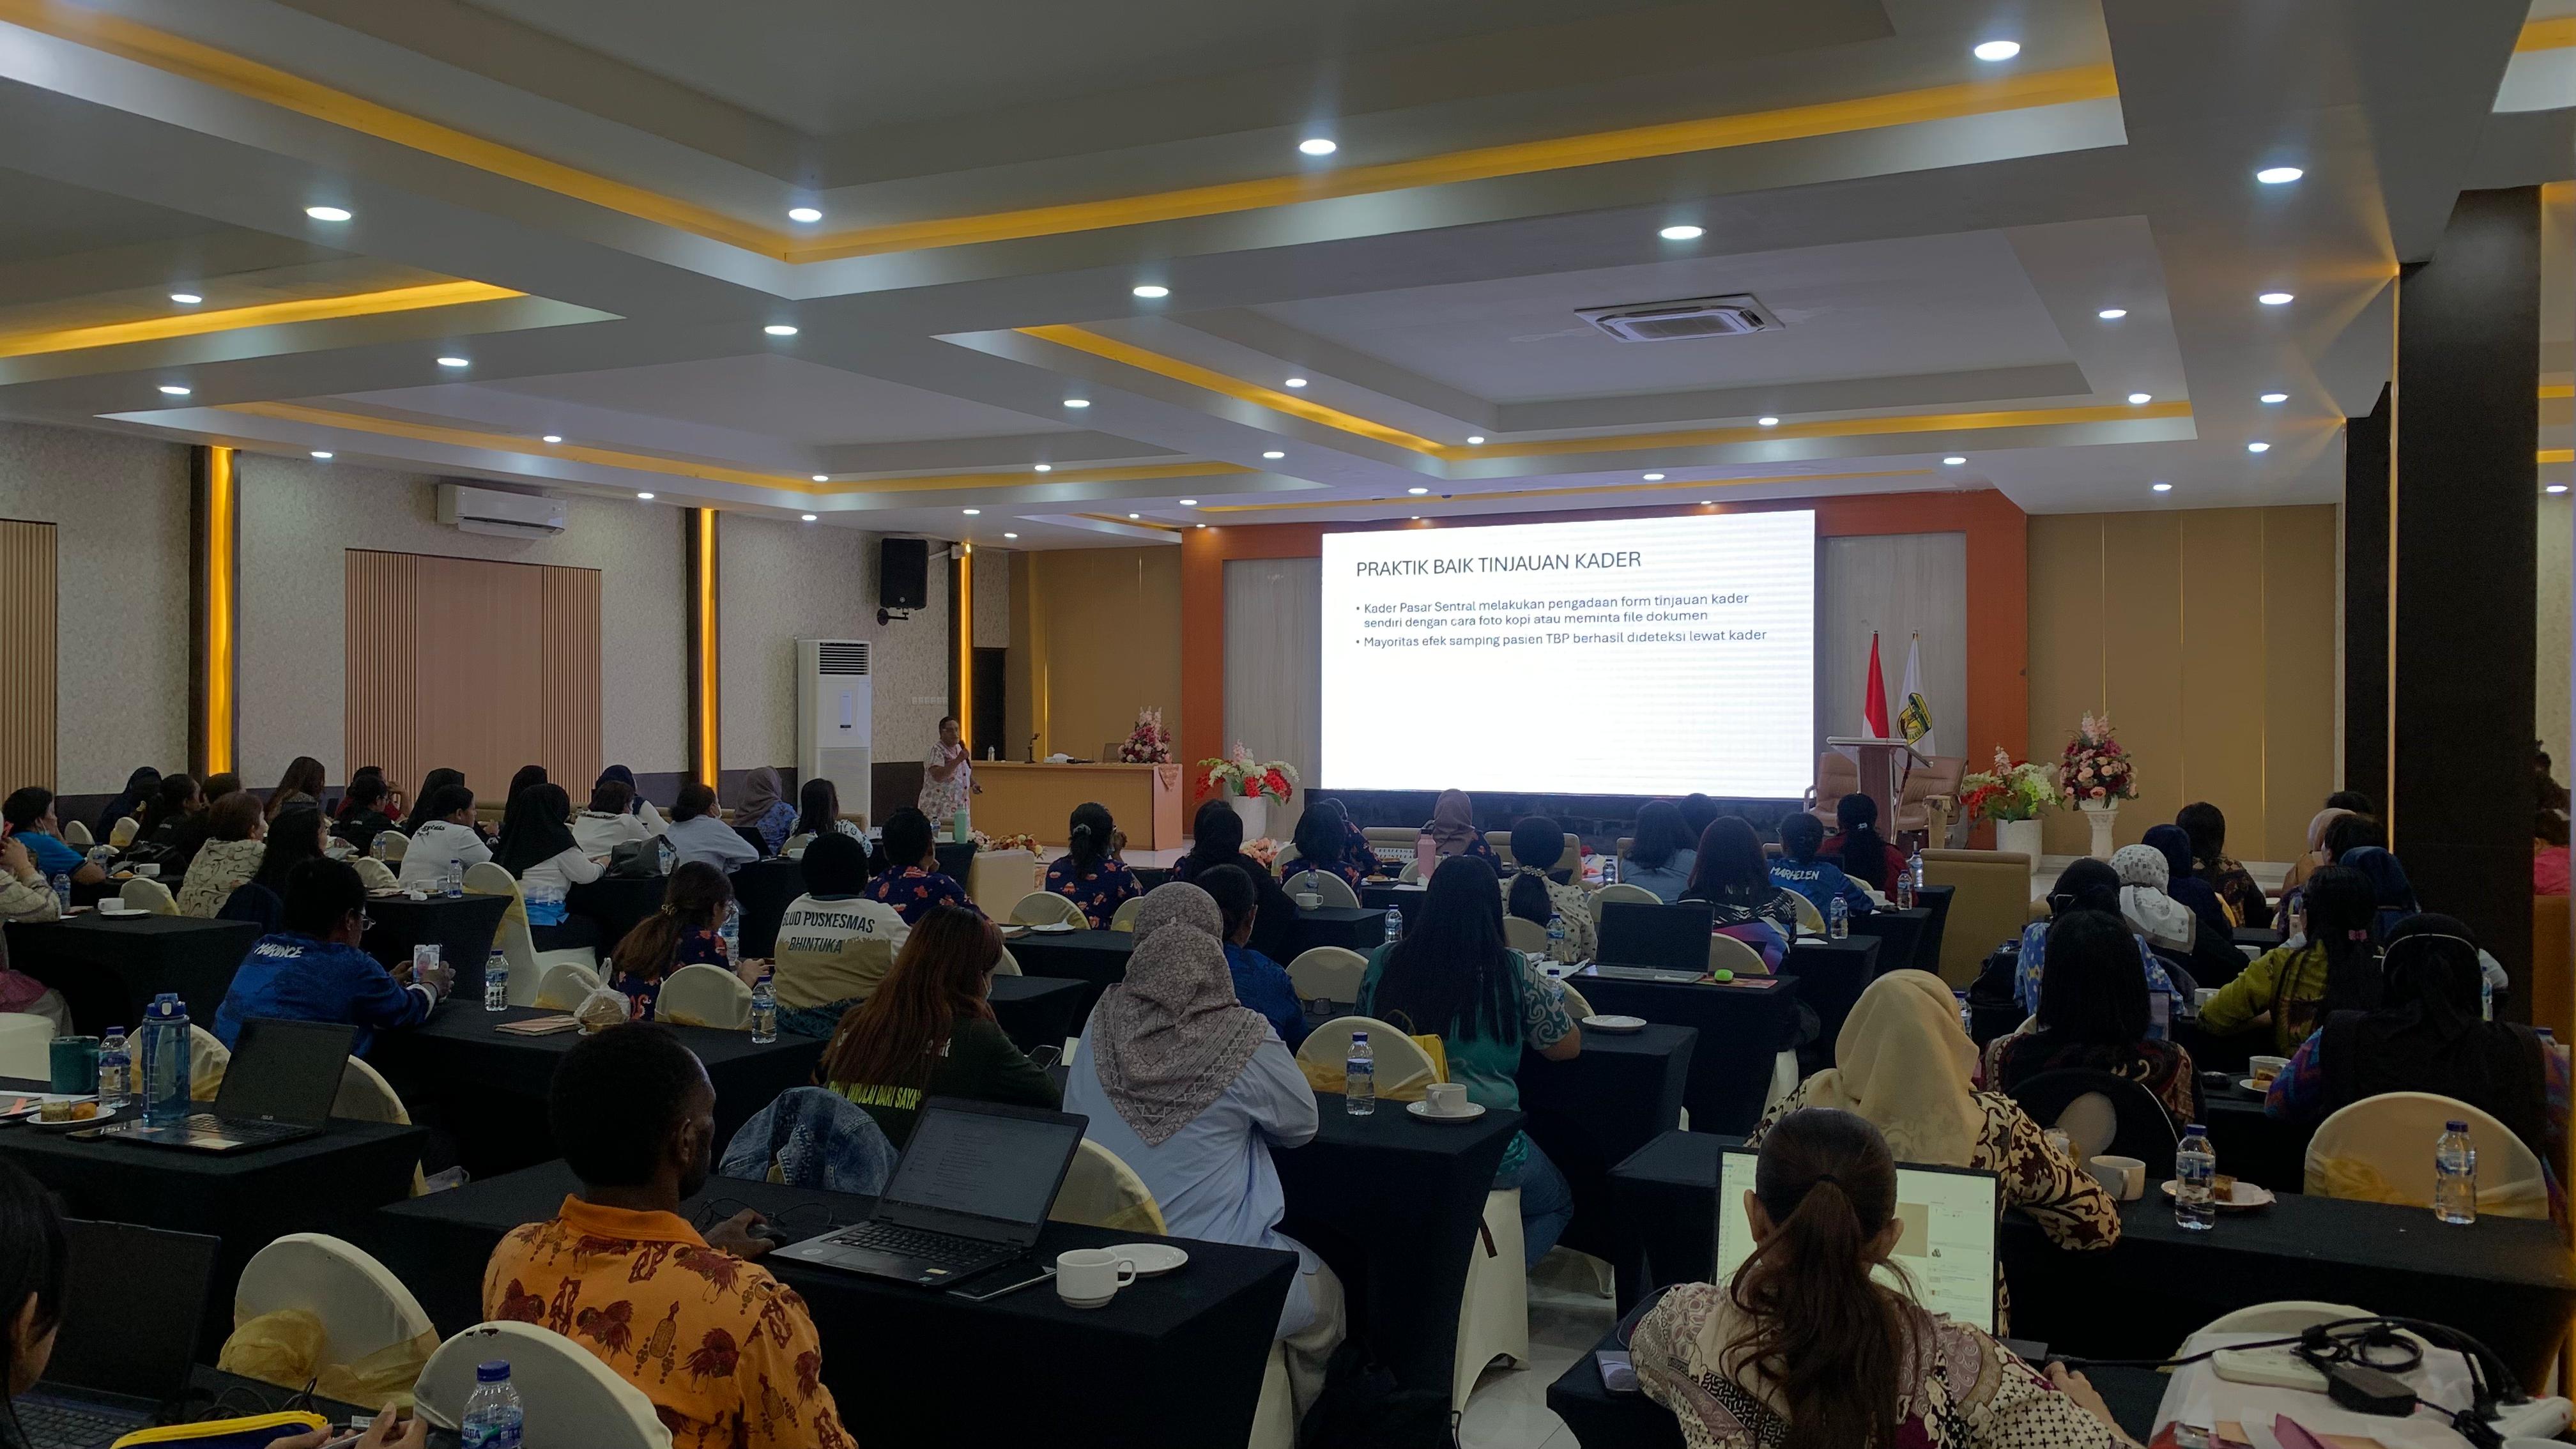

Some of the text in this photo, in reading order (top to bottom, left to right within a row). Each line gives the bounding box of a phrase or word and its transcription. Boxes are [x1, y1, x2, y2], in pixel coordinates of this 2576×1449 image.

[1356, 551, 1641, 577] PRAKTIK BAIK TINJAUAN KADER
[1364, 592, 1749, 614] Kader Pasar Sentral melakukan pengadaan form tinjauan kader
[1364, 611, 1708, 629] sendiri dengan cara foto kopi atau meminta file dokumen
[1364, 629, 1767, 649] Mayoritas efek samping pasien TBP berhasil dideteksi lewat kader
[803, 910, 876, 933] PUSKESMAS
[788, 936, 843, 954] BHINTUKA
[875, 1085, 896, 1107] DARI
